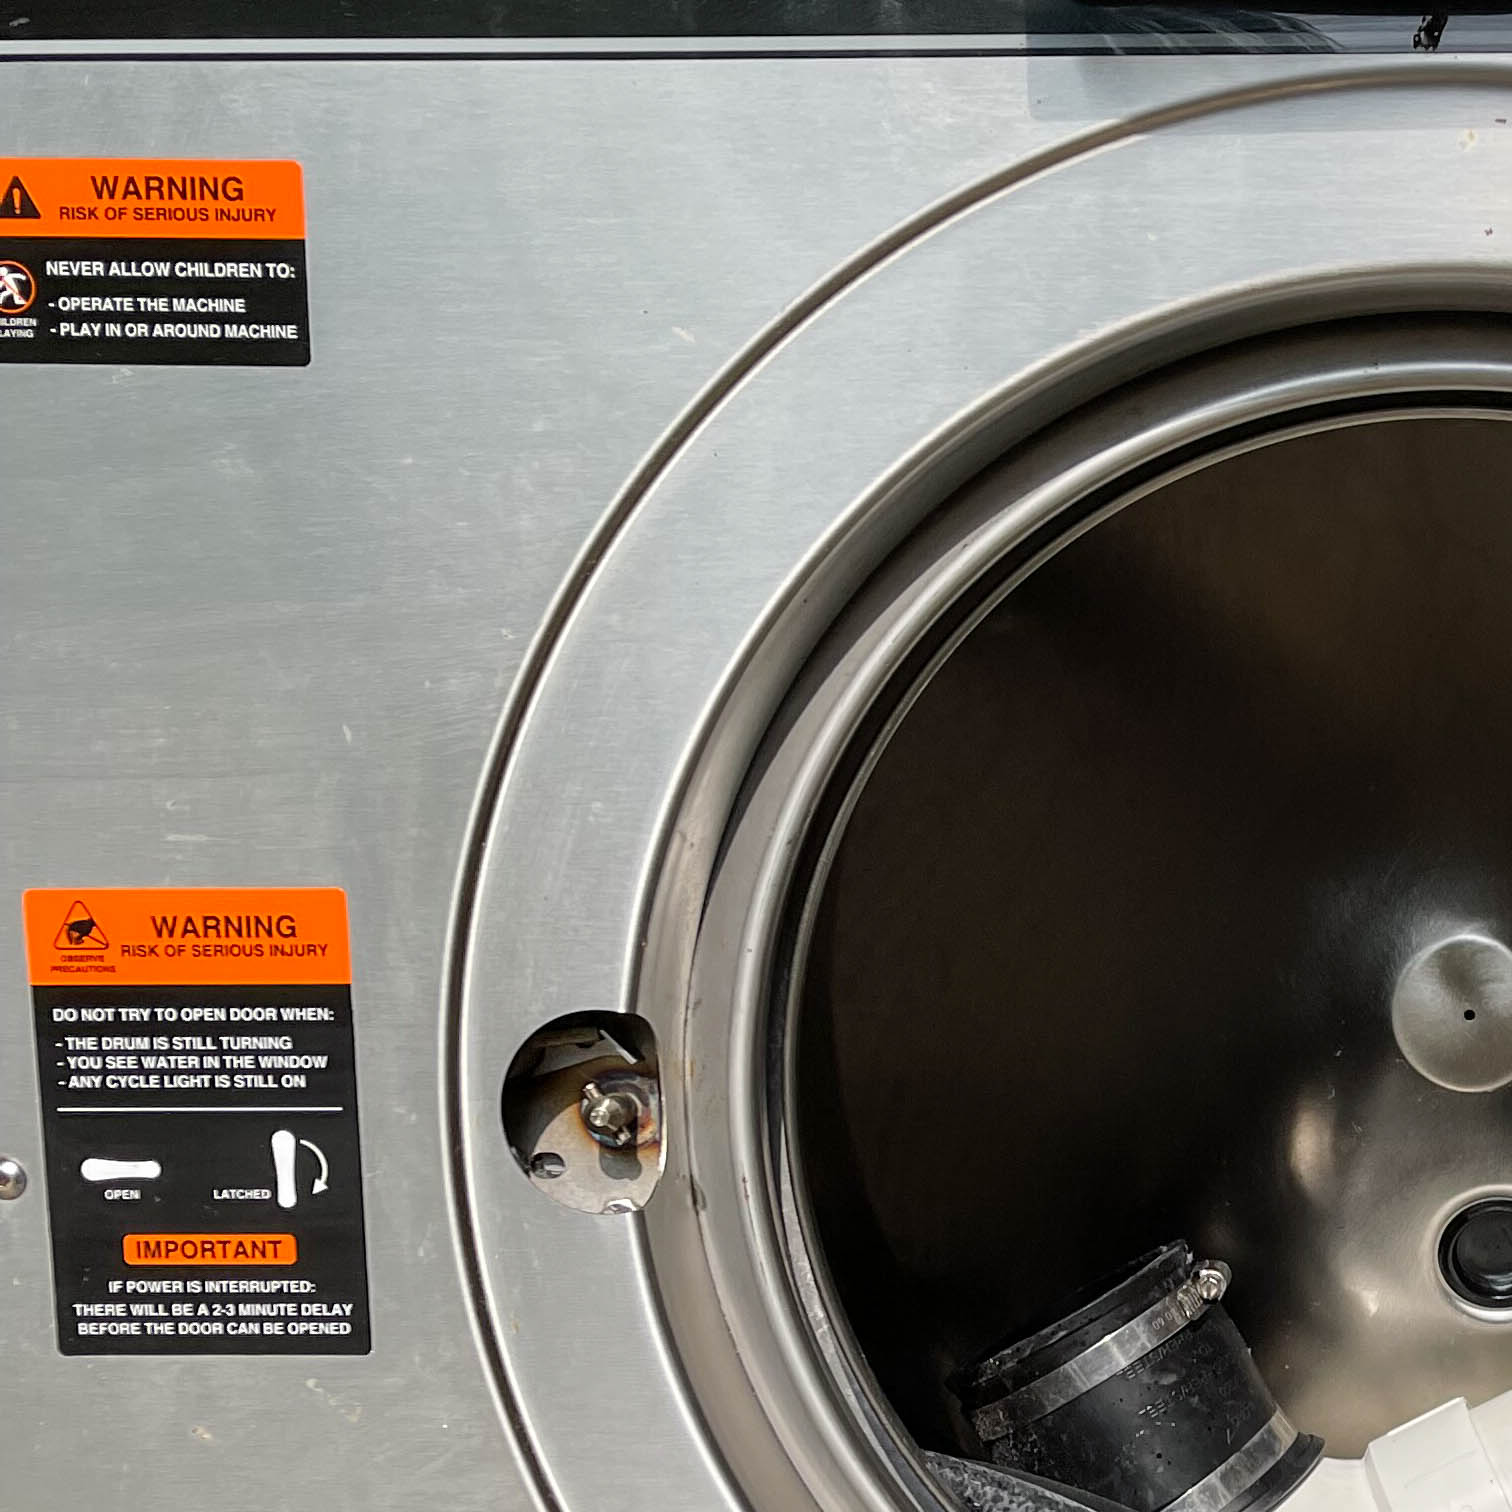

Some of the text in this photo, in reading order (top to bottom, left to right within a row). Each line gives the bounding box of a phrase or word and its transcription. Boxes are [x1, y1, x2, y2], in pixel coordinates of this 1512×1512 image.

[91, 176, 243, 201] WARNING
[60, 207, 275, 221] RISK OF SERIOUS INJURY
[46, 261, 295, 278] NEVER ALLOW CHILDREN TO:
[137, 298, 170, 312] THE
[173, 298, 246, 312] MACHINE
[105, 323, 122, 337] IN
[125, 323, 148, 337] OR
[152, 324, 221, 338] AROUND
[224, 324, 298, 339] MACHINE
[152, 915, 296, 938] WARNING
[122, 944, 327, 957] RISK OF SERIOUS INJURY
[53, 1008, 334, 1021] DO NOT TRY TO OPEN DOOR WHEN:
[102, 1037, 150, 1050] DRUM
[153, 1037, 170, 1050] IS
[172, 1037, 217, 1050] STILL
[219, 1036, 293, 1049] TURNING
[105, 1056, 138, 1069] SEE
[141, 1056, 200, 1068] WATER
[203, 1056, 220, 1068] IN
[222, 1056, 256, 1068] THE
[258, 1056, 328, 1068] WINDOW
[106, 1075, 160, 1088] CYCLE
[164, 1075, 212, 1088] LIGHT
[215, 1075, 231, 1088] IS
[234, 1075, 278, 1088] STILL
[281, 1075, 306, 1088] ON
[105, 1190, 140, 1199] OPEN
[214, 1189, 271, 1199] LATCHED
[137, 1240, 281, 1259] IMPORTANT
[109, 1280, 316, 1293] IF POWER IS INTERRUPTED:
[72, 1304, 353, 1316] THERE WILL BE A 2-3 MINUTE DELAY
[78, 1322, 351, 1335] BEFORE THE DOOR CAN BE OPENED
